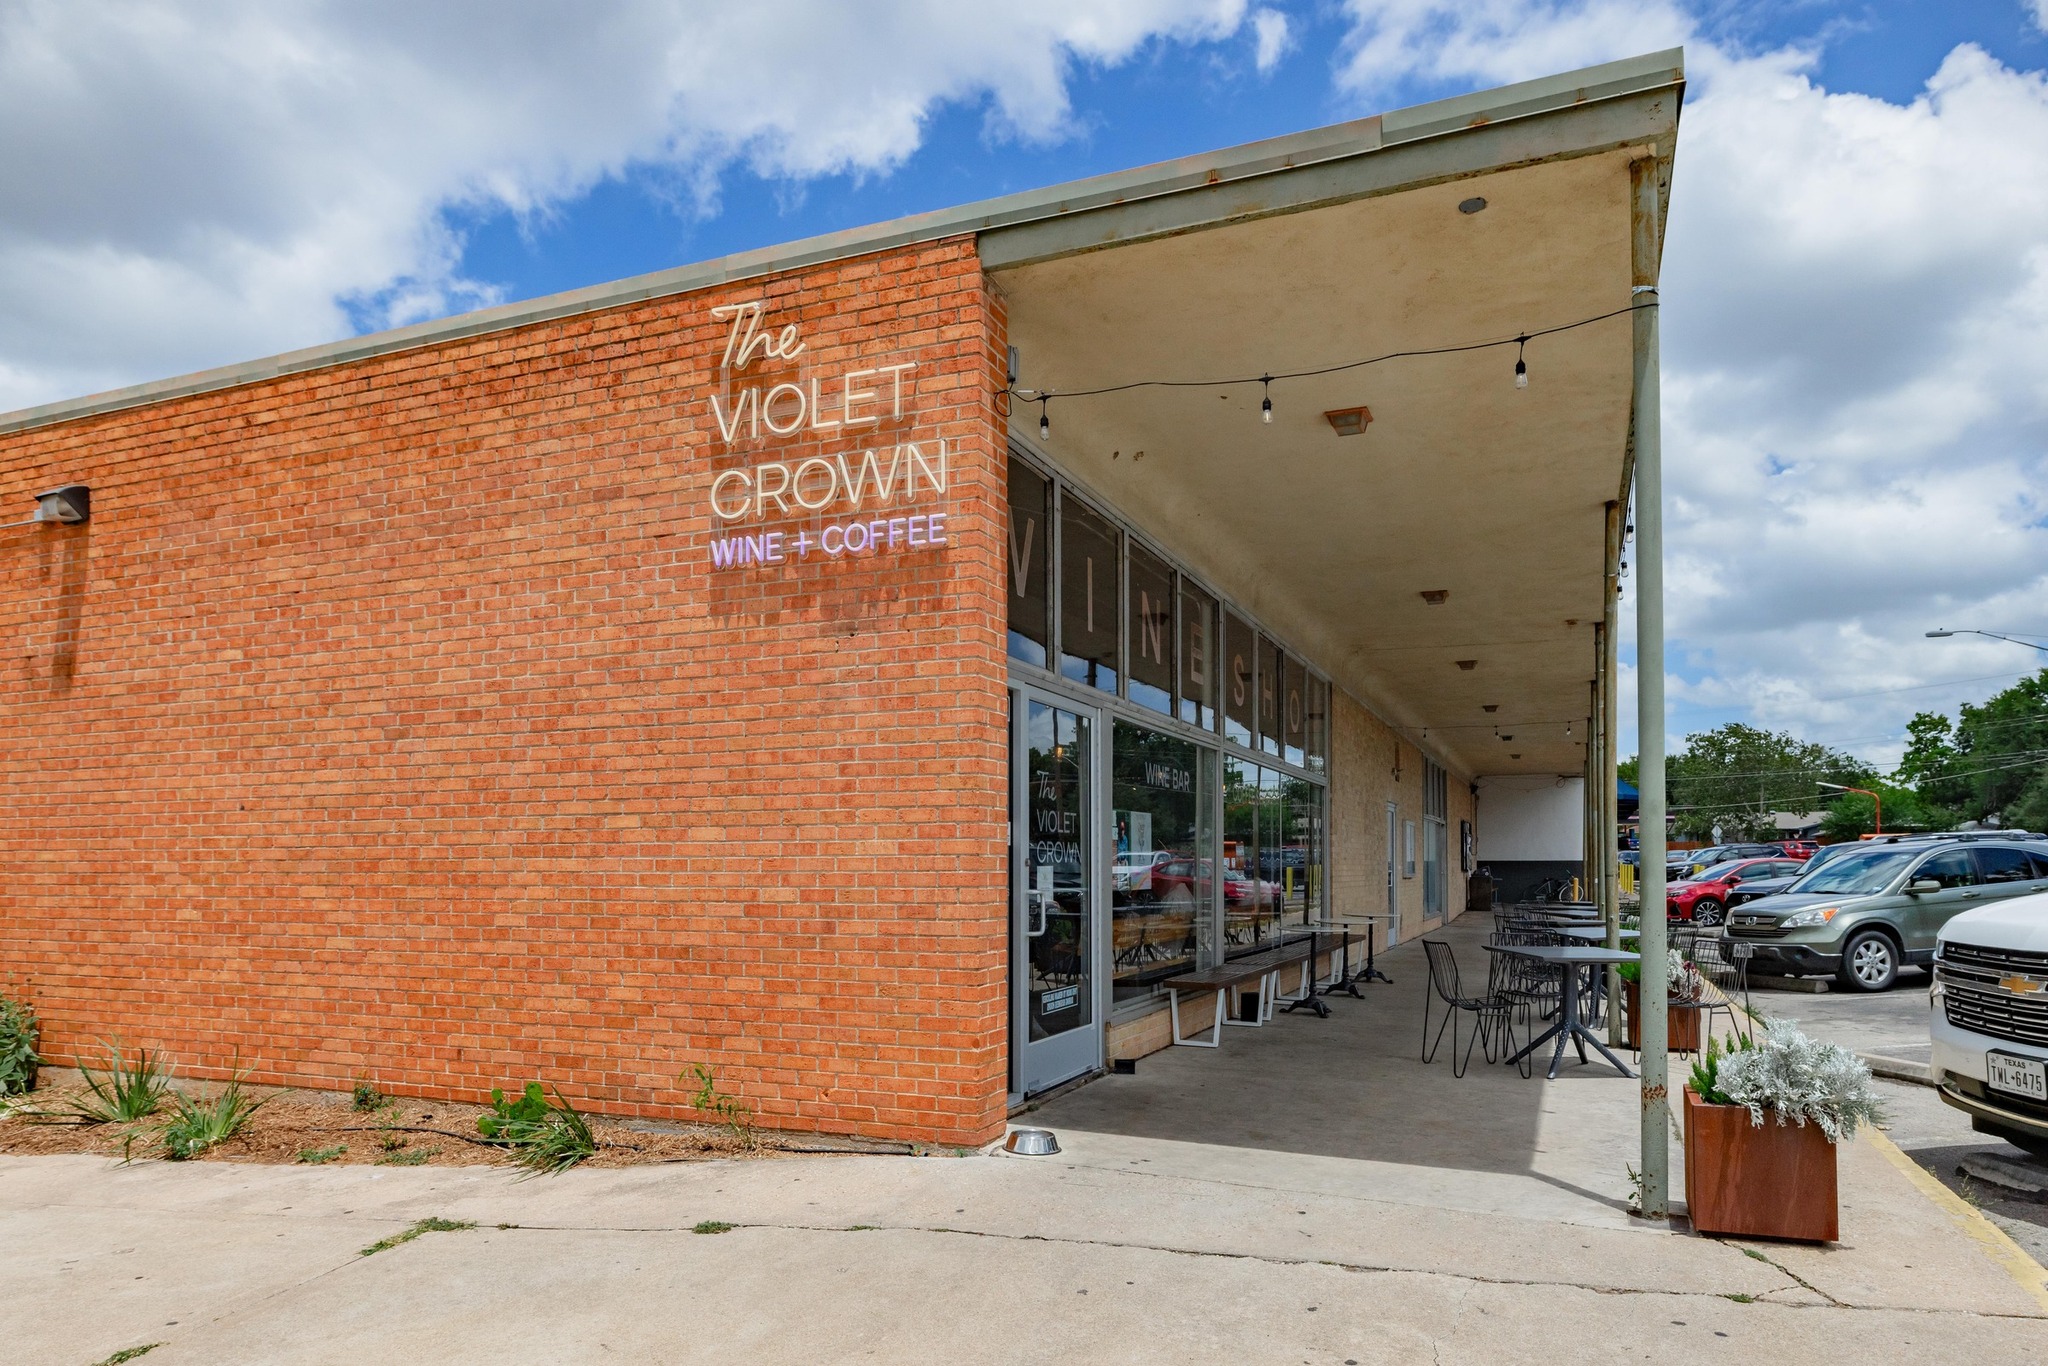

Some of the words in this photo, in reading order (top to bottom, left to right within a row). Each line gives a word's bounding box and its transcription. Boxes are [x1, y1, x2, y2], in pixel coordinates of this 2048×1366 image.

[711, 302, 806, 367] The
[711, 361, 919, 442] VIOLET
[711, 439, 946, 519] CROWN
[711, 532, 783, 566] WINE
[792, 531, 813, 555] +
[821, 513, 947, 554] COFFEE
[1037, 770, 1057, 801] The
[1145, 761, 1170, 788] WINE
[1172, 768, 1190, 792] BAR
[1037, 809, 1077, 834] VIOLET
[1037, 841, 1081, 864] CROWN
[2003, 1058, 2026, 1069] TEXAS
